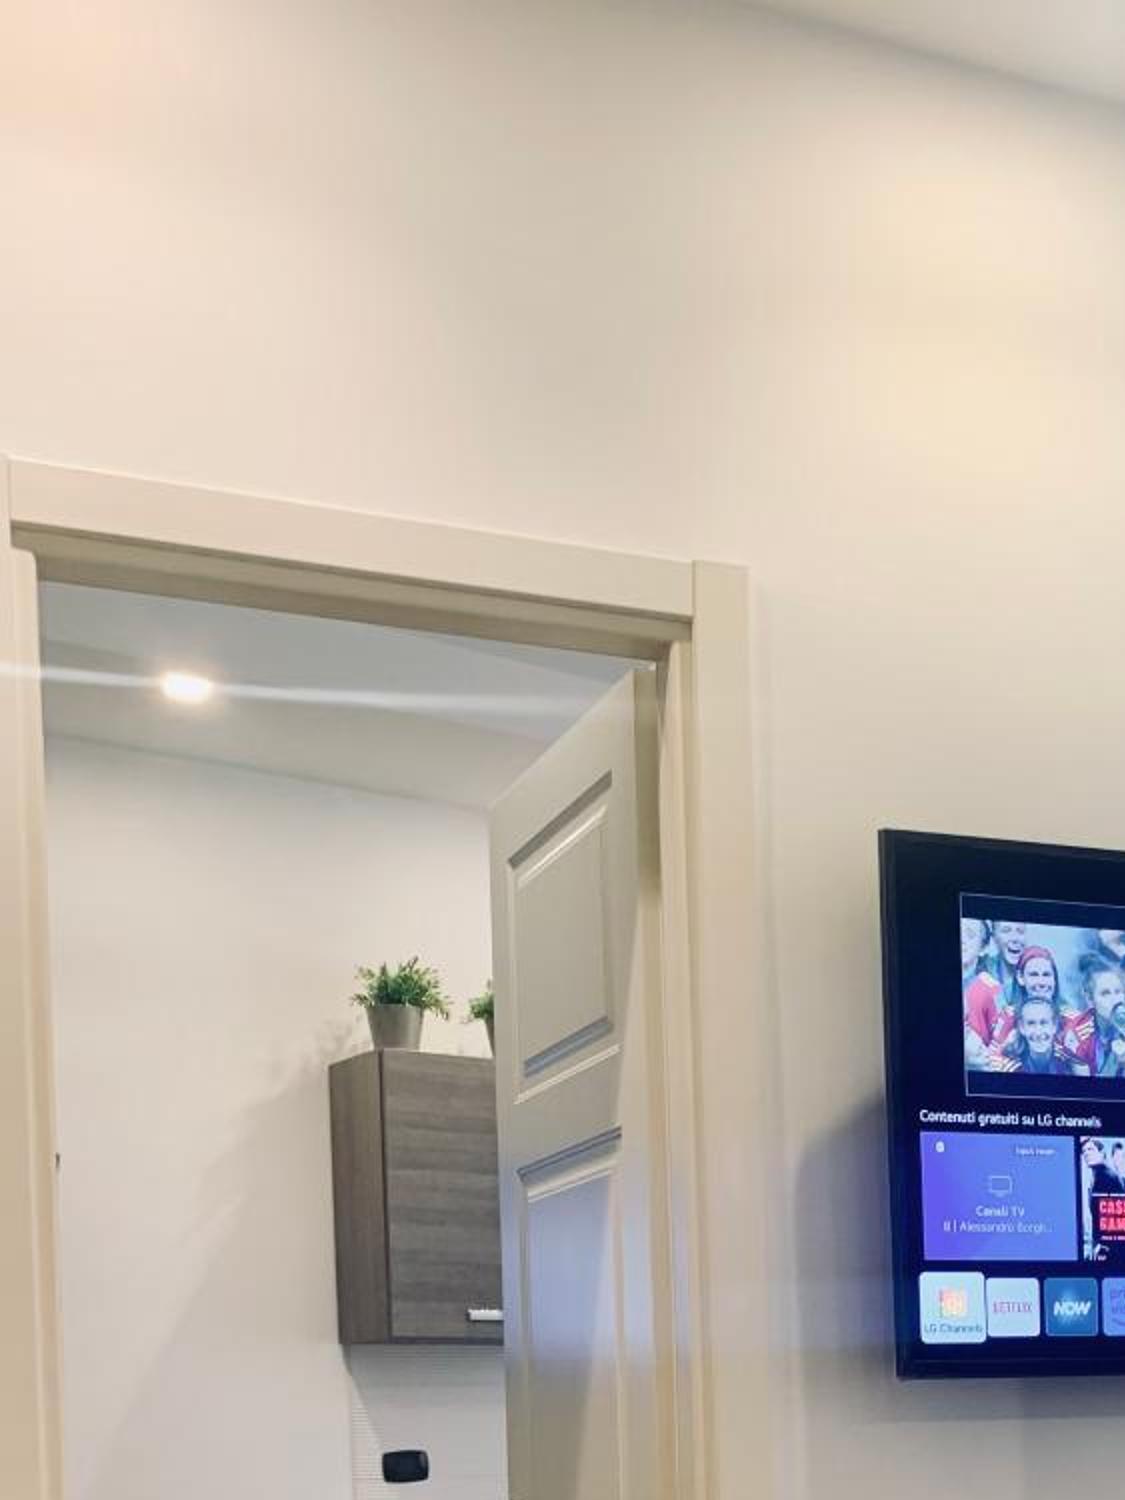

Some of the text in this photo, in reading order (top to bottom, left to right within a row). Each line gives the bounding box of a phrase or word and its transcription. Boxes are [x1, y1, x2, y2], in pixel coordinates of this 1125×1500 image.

[919, 1109, 1102, 1128] Contenuti gratuiti su LG channels
[975, 1204, 1025, 1217] Canali TV
[1053, 1300, 1092, 1317] NOW
